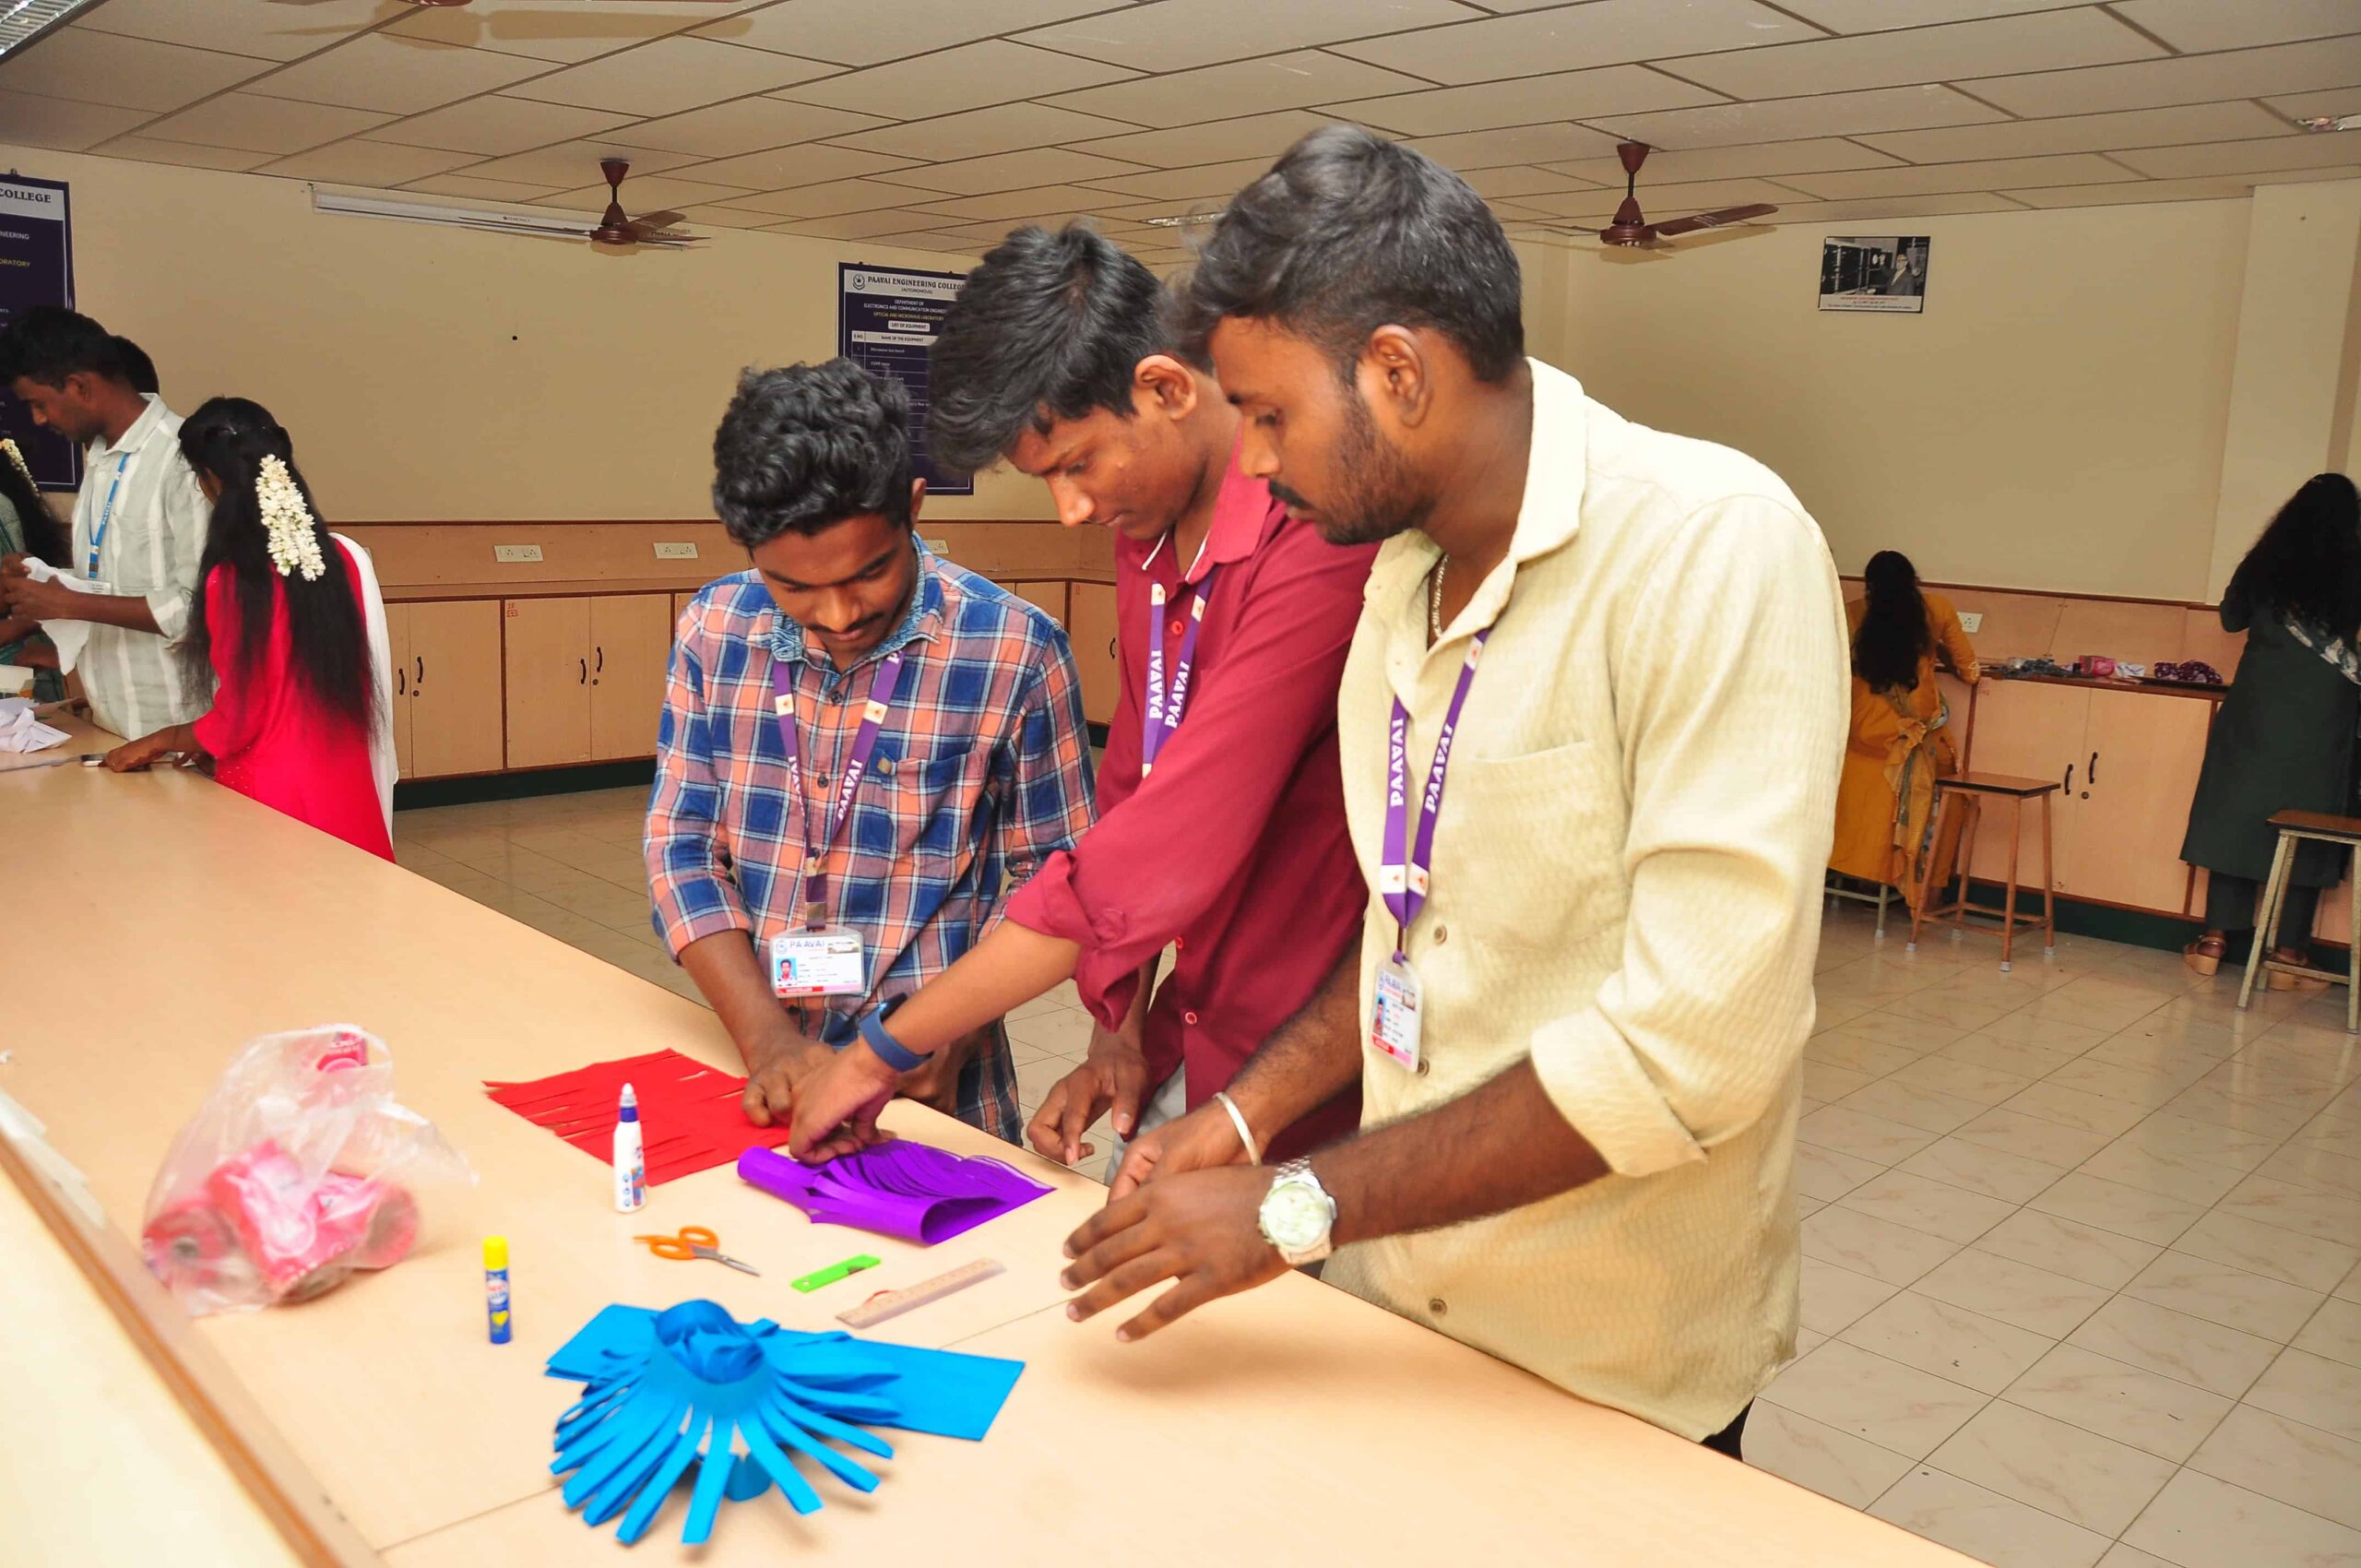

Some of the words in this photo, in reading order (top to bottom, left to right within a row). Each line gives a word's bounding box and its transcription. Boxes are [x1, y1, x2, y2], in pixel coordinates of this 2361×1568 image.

[867, 276, 891, 284] PAAVAI
[892, 279, 937, 289] ENGINEERING
[937, 282, 965, 291] COLLEG
[1148, 649, 1164, 719] PAAVAI
[1164, 660, 1191, 730] PAAVAI
[837, 758, 863, 821] PAAVAI
[1390, 716, 1405, 807] PAAVAI
[1424, 722, 1454, 814] PAAVAI
